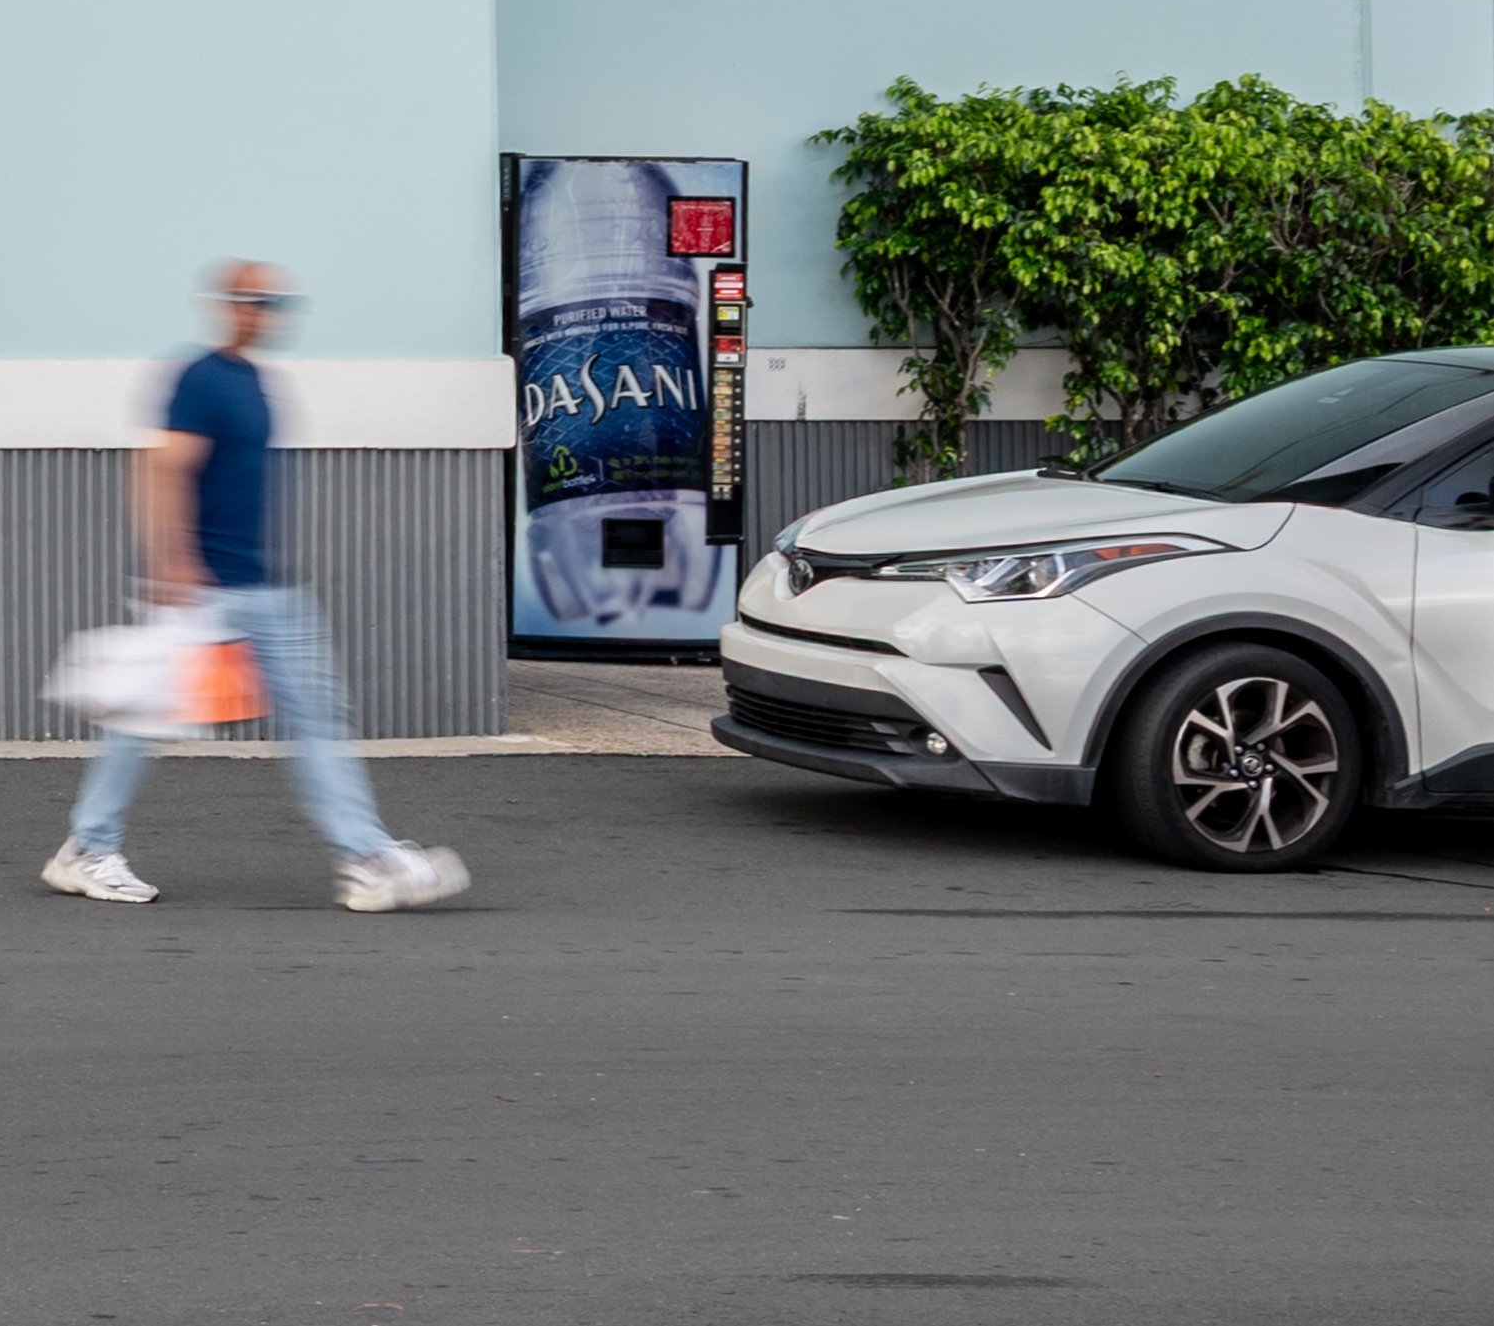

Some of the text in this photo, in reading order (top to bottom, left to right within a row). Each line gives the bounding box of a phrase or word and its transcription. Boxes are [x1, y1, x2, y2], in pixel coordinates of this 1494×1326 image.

[553, 305, 647, 326] PURIFIED WATER
[523, 353, 698, 427] DASANI
